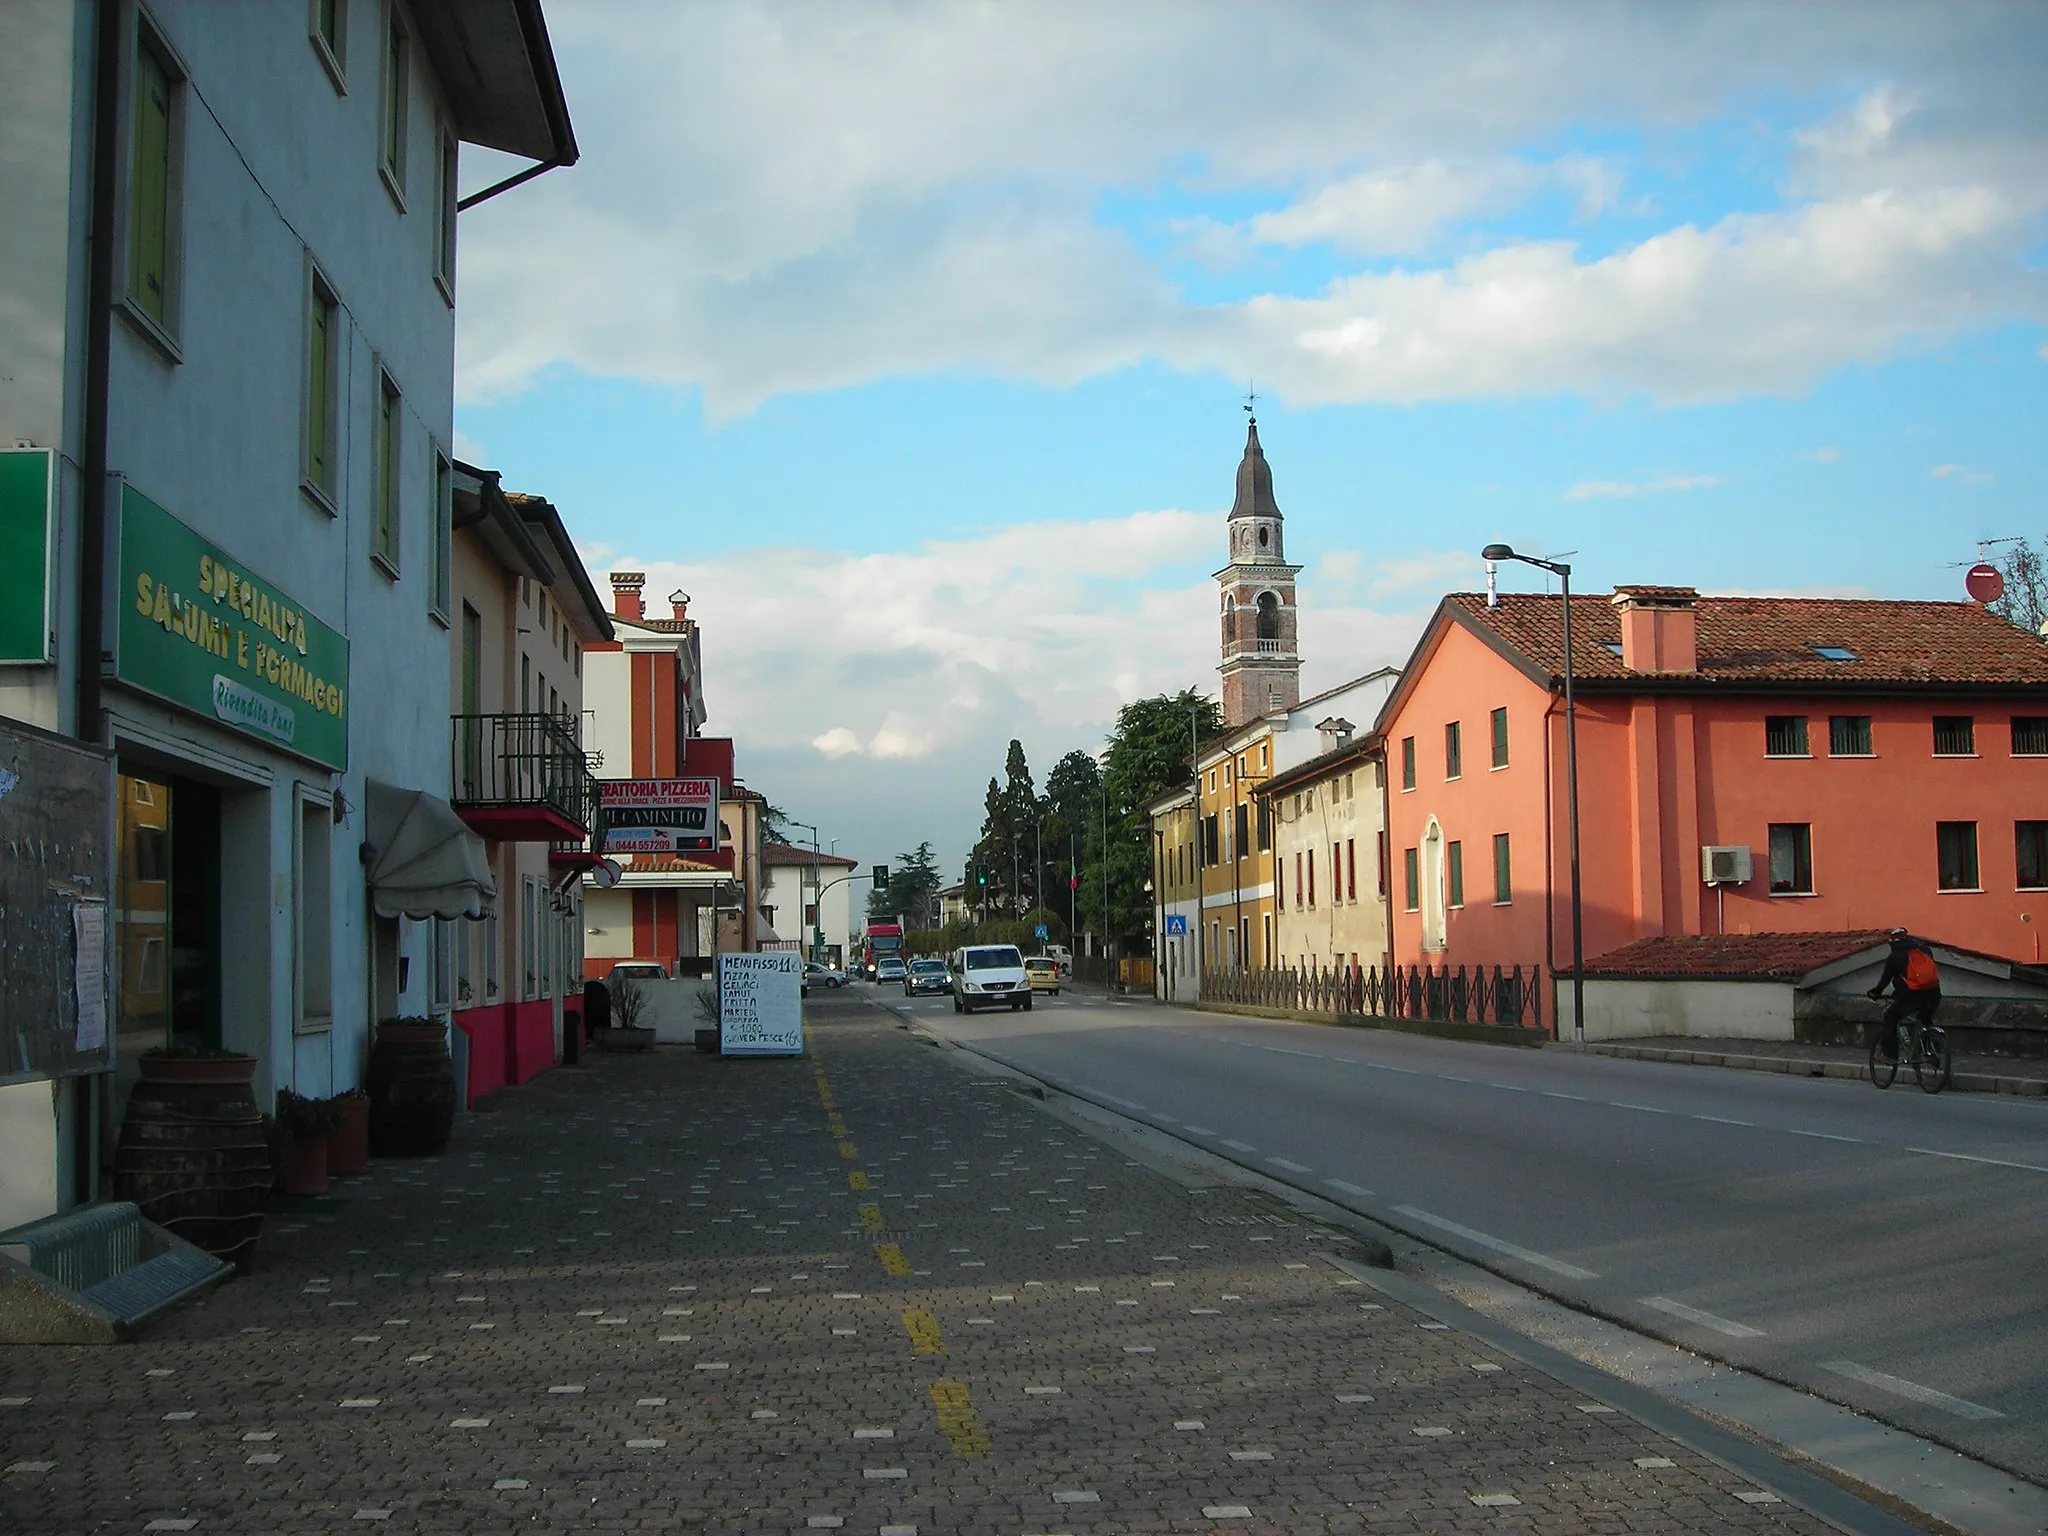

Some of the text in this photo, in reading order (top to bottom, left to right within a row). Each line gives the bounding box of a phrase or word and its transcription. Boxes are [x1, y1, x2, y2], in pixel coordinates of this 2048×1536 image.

[135, 572, 344, 720] SALUMI E FORMAGGI
[217, 681, 269, 726] Rivendita
[661, 781, 711, 796] PIZZERIA
[621, 809, 702, 824] CAMINETTO
[616, 840, 637, 850] 0444
[724, 972, 749, 980] PIZZA
[724, 998, 757, 1007] FRITTA
